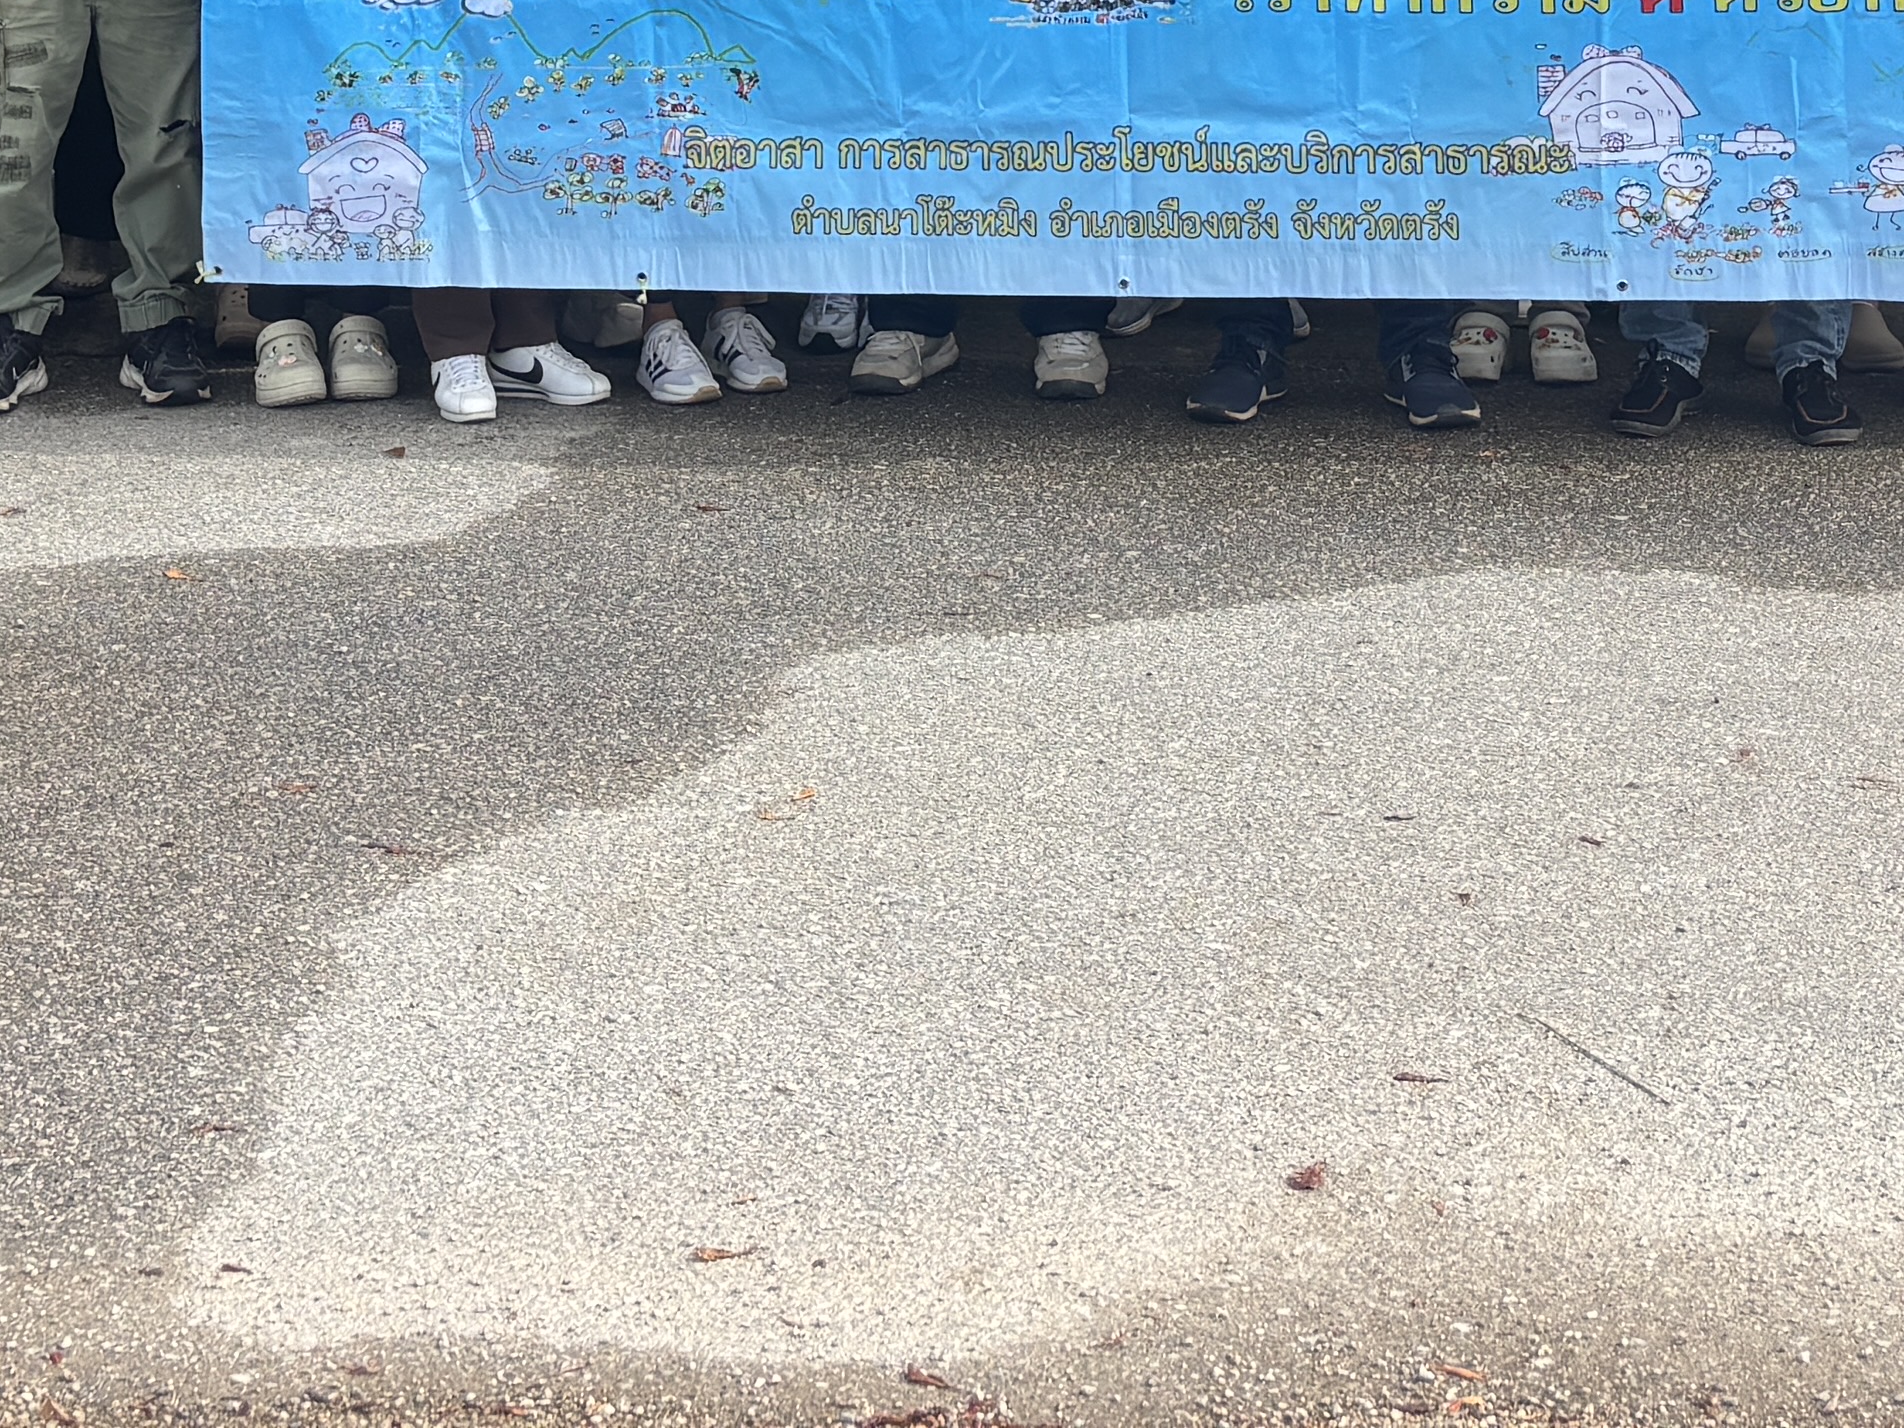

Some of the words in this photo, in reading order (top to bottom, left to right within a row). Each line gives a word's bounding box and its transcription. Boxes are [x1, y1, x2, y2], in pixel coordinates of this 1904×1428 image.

[684, 125, 824, 171] จิตอาสา
[837, 125, 1574, 176] การสาธารณประโยชน์และบริการสาธารณะ
[791, 194, 1038, 238] ตำบลนาโต๊ะหมิง
[1047, 196, 1280, 241] อำเภอเมืองตรัง
[1290, 198, 1461, 241] จังหวัดตรัง
